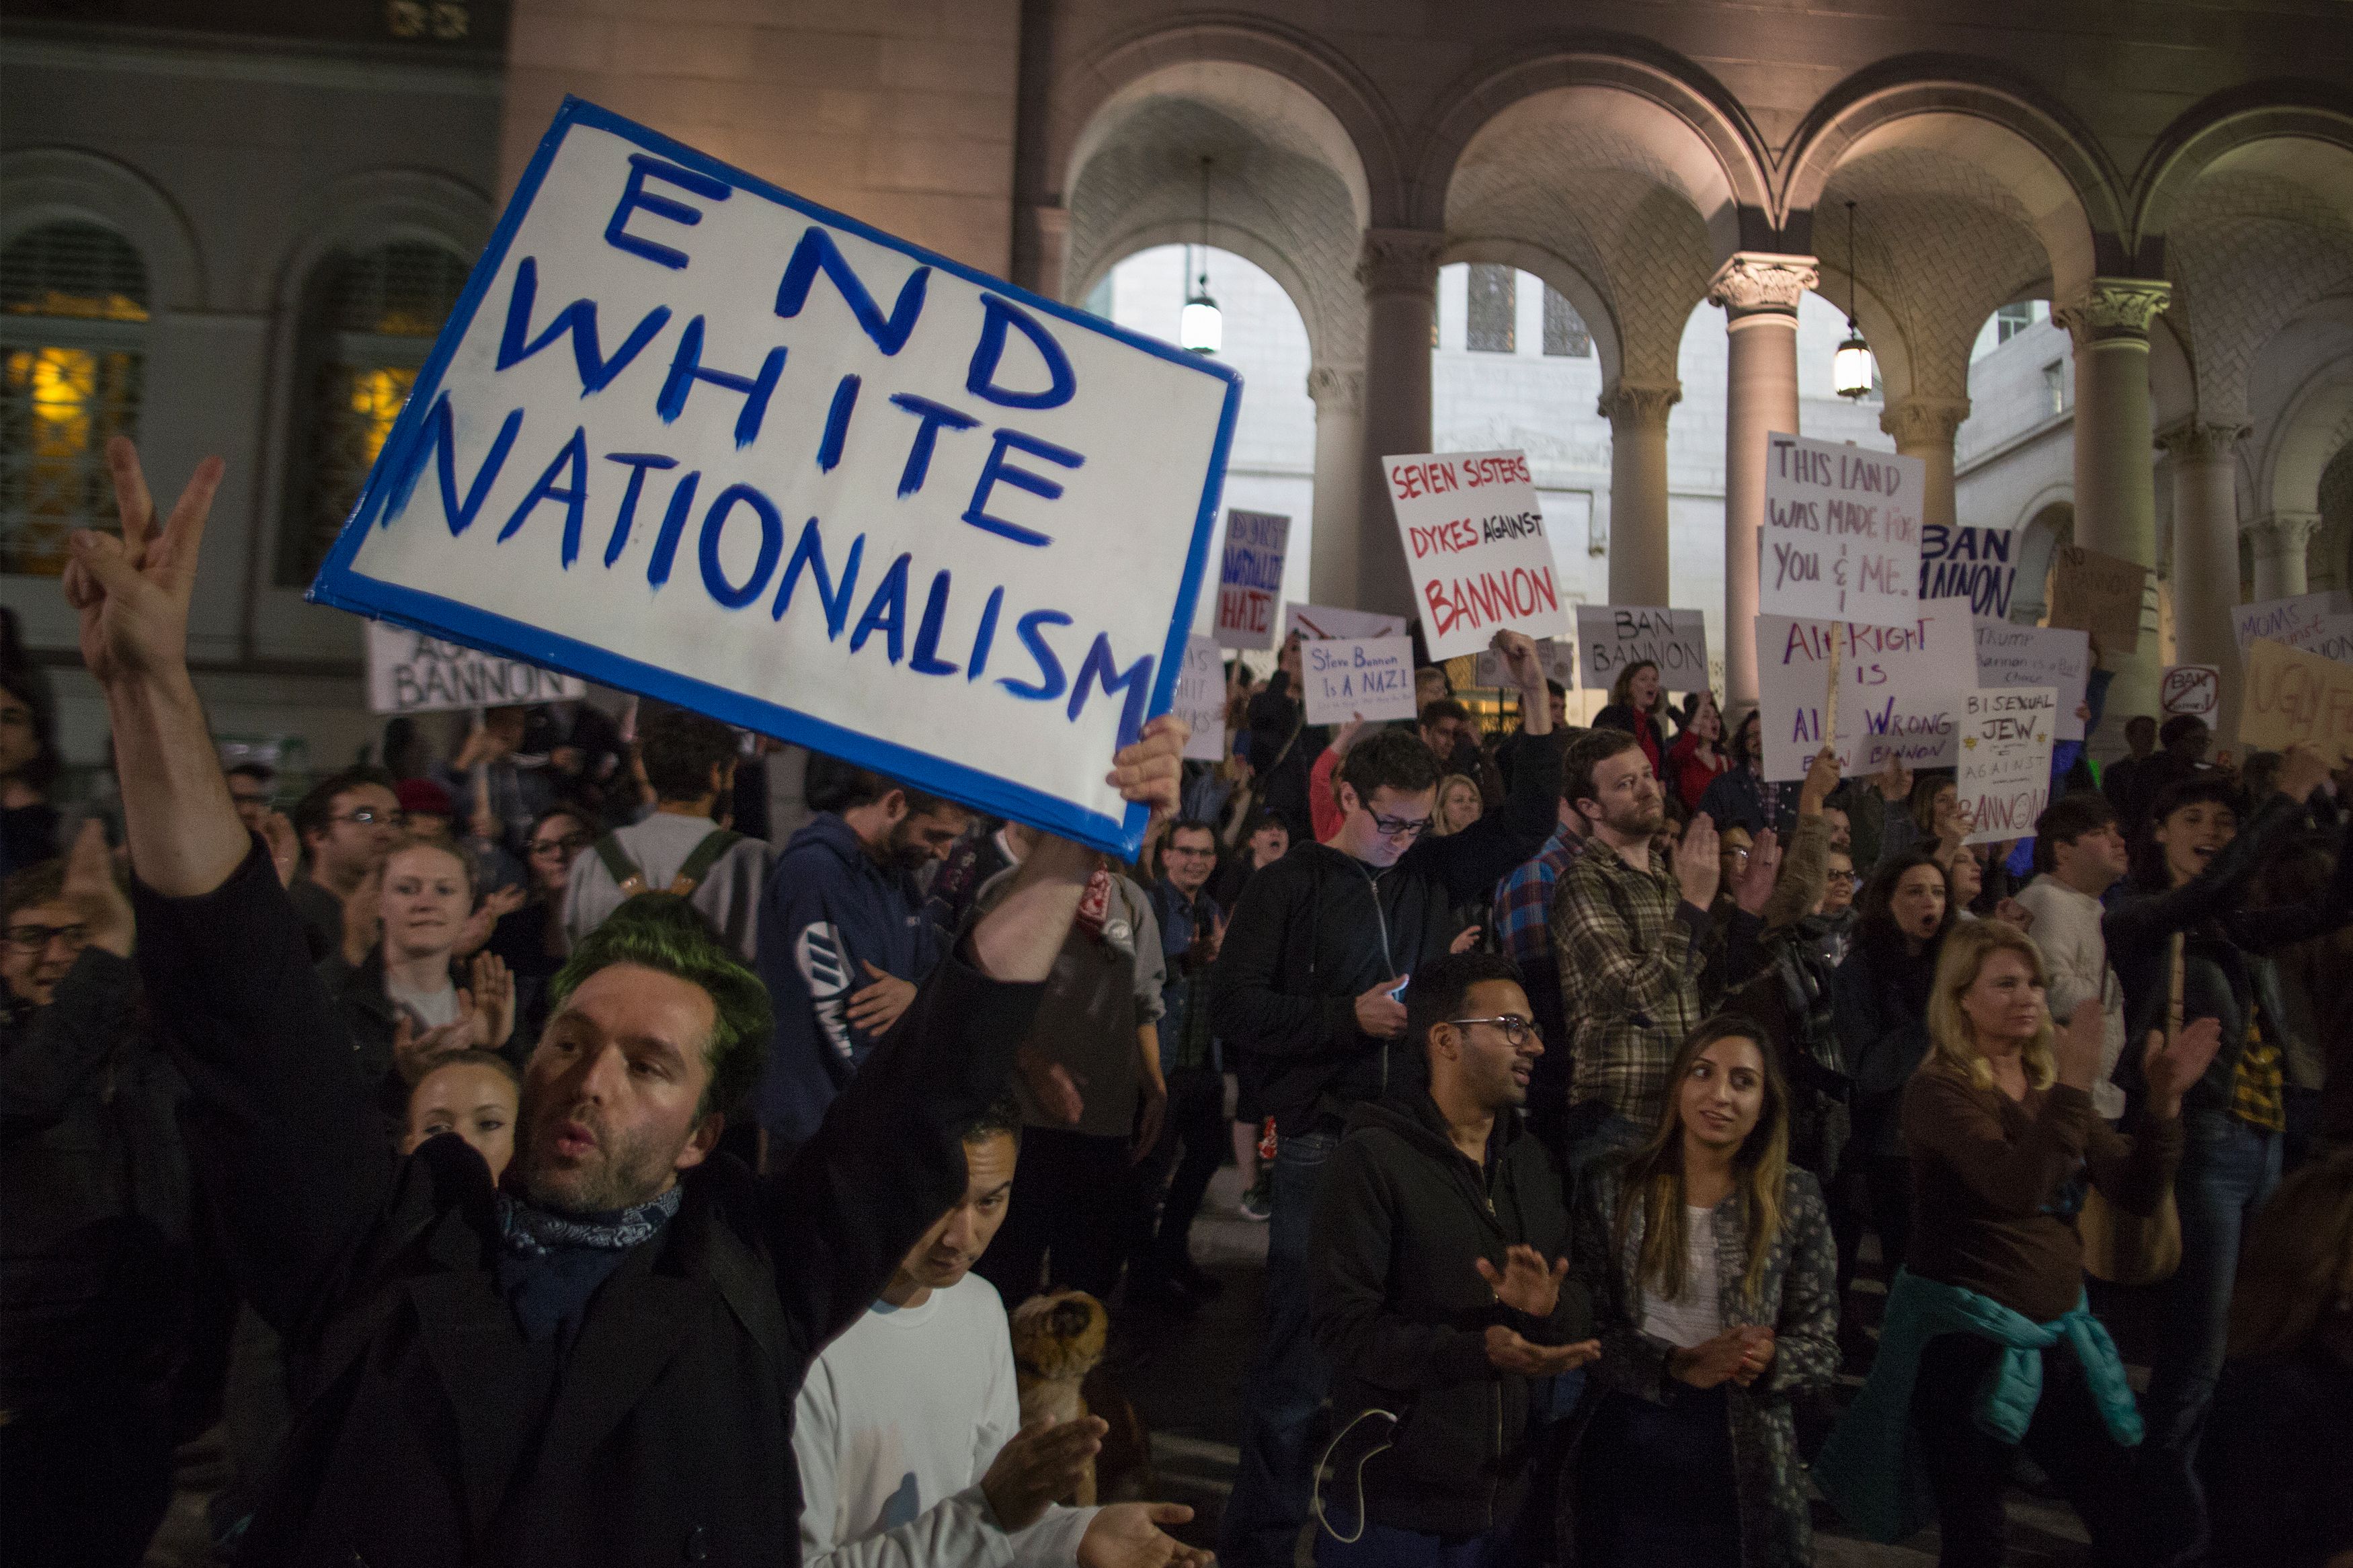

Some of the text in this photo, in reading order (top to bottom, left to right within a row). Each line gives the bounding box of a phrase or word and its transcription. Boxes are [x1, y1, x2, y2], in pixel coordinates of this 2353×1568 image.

[604, 151, 1076, 410] END
[495, 255, 1086, 546] WHITE
[1392, 456, 1531, 500] SEVEN SISTERS
[1773, 440, 1901, 497] THIS LAND
[1409, 511, 1542, 559] DYKES AGAINST
[1770, 498, 1820, 532] WAS
[1827, 499, 1878, 538] MADE
[1921, 524, 2011, 562] BAN
[381, 389, 1156, 758] NATIONALISM
[1220, 589, 1272, 632] HATE
[1425, 565, 1558, 638] BANNON
[1615, 610, 1674, 639] BAN
[2241, 604, 2299, 645] MOMS
[1312, 646, 1398, 671] Steve Bannon
[1592, 641, 1704, 671] BANNON
[1858, 664, 1887, 685] IS
[393, 660, 565, 706] BANNON
[1343, 674, 1353, 697] A
[1363, 669, 1406, 693] NAZI
[1865, 695, 1950, 737] WRONG
[1968, 694, 2055, 714] BISEXUAL
[1982, 715, 2037, 740] JEW
[1802, 749, 1850, 773] BN
[1964, 755, 2046, 780] AGAINST
